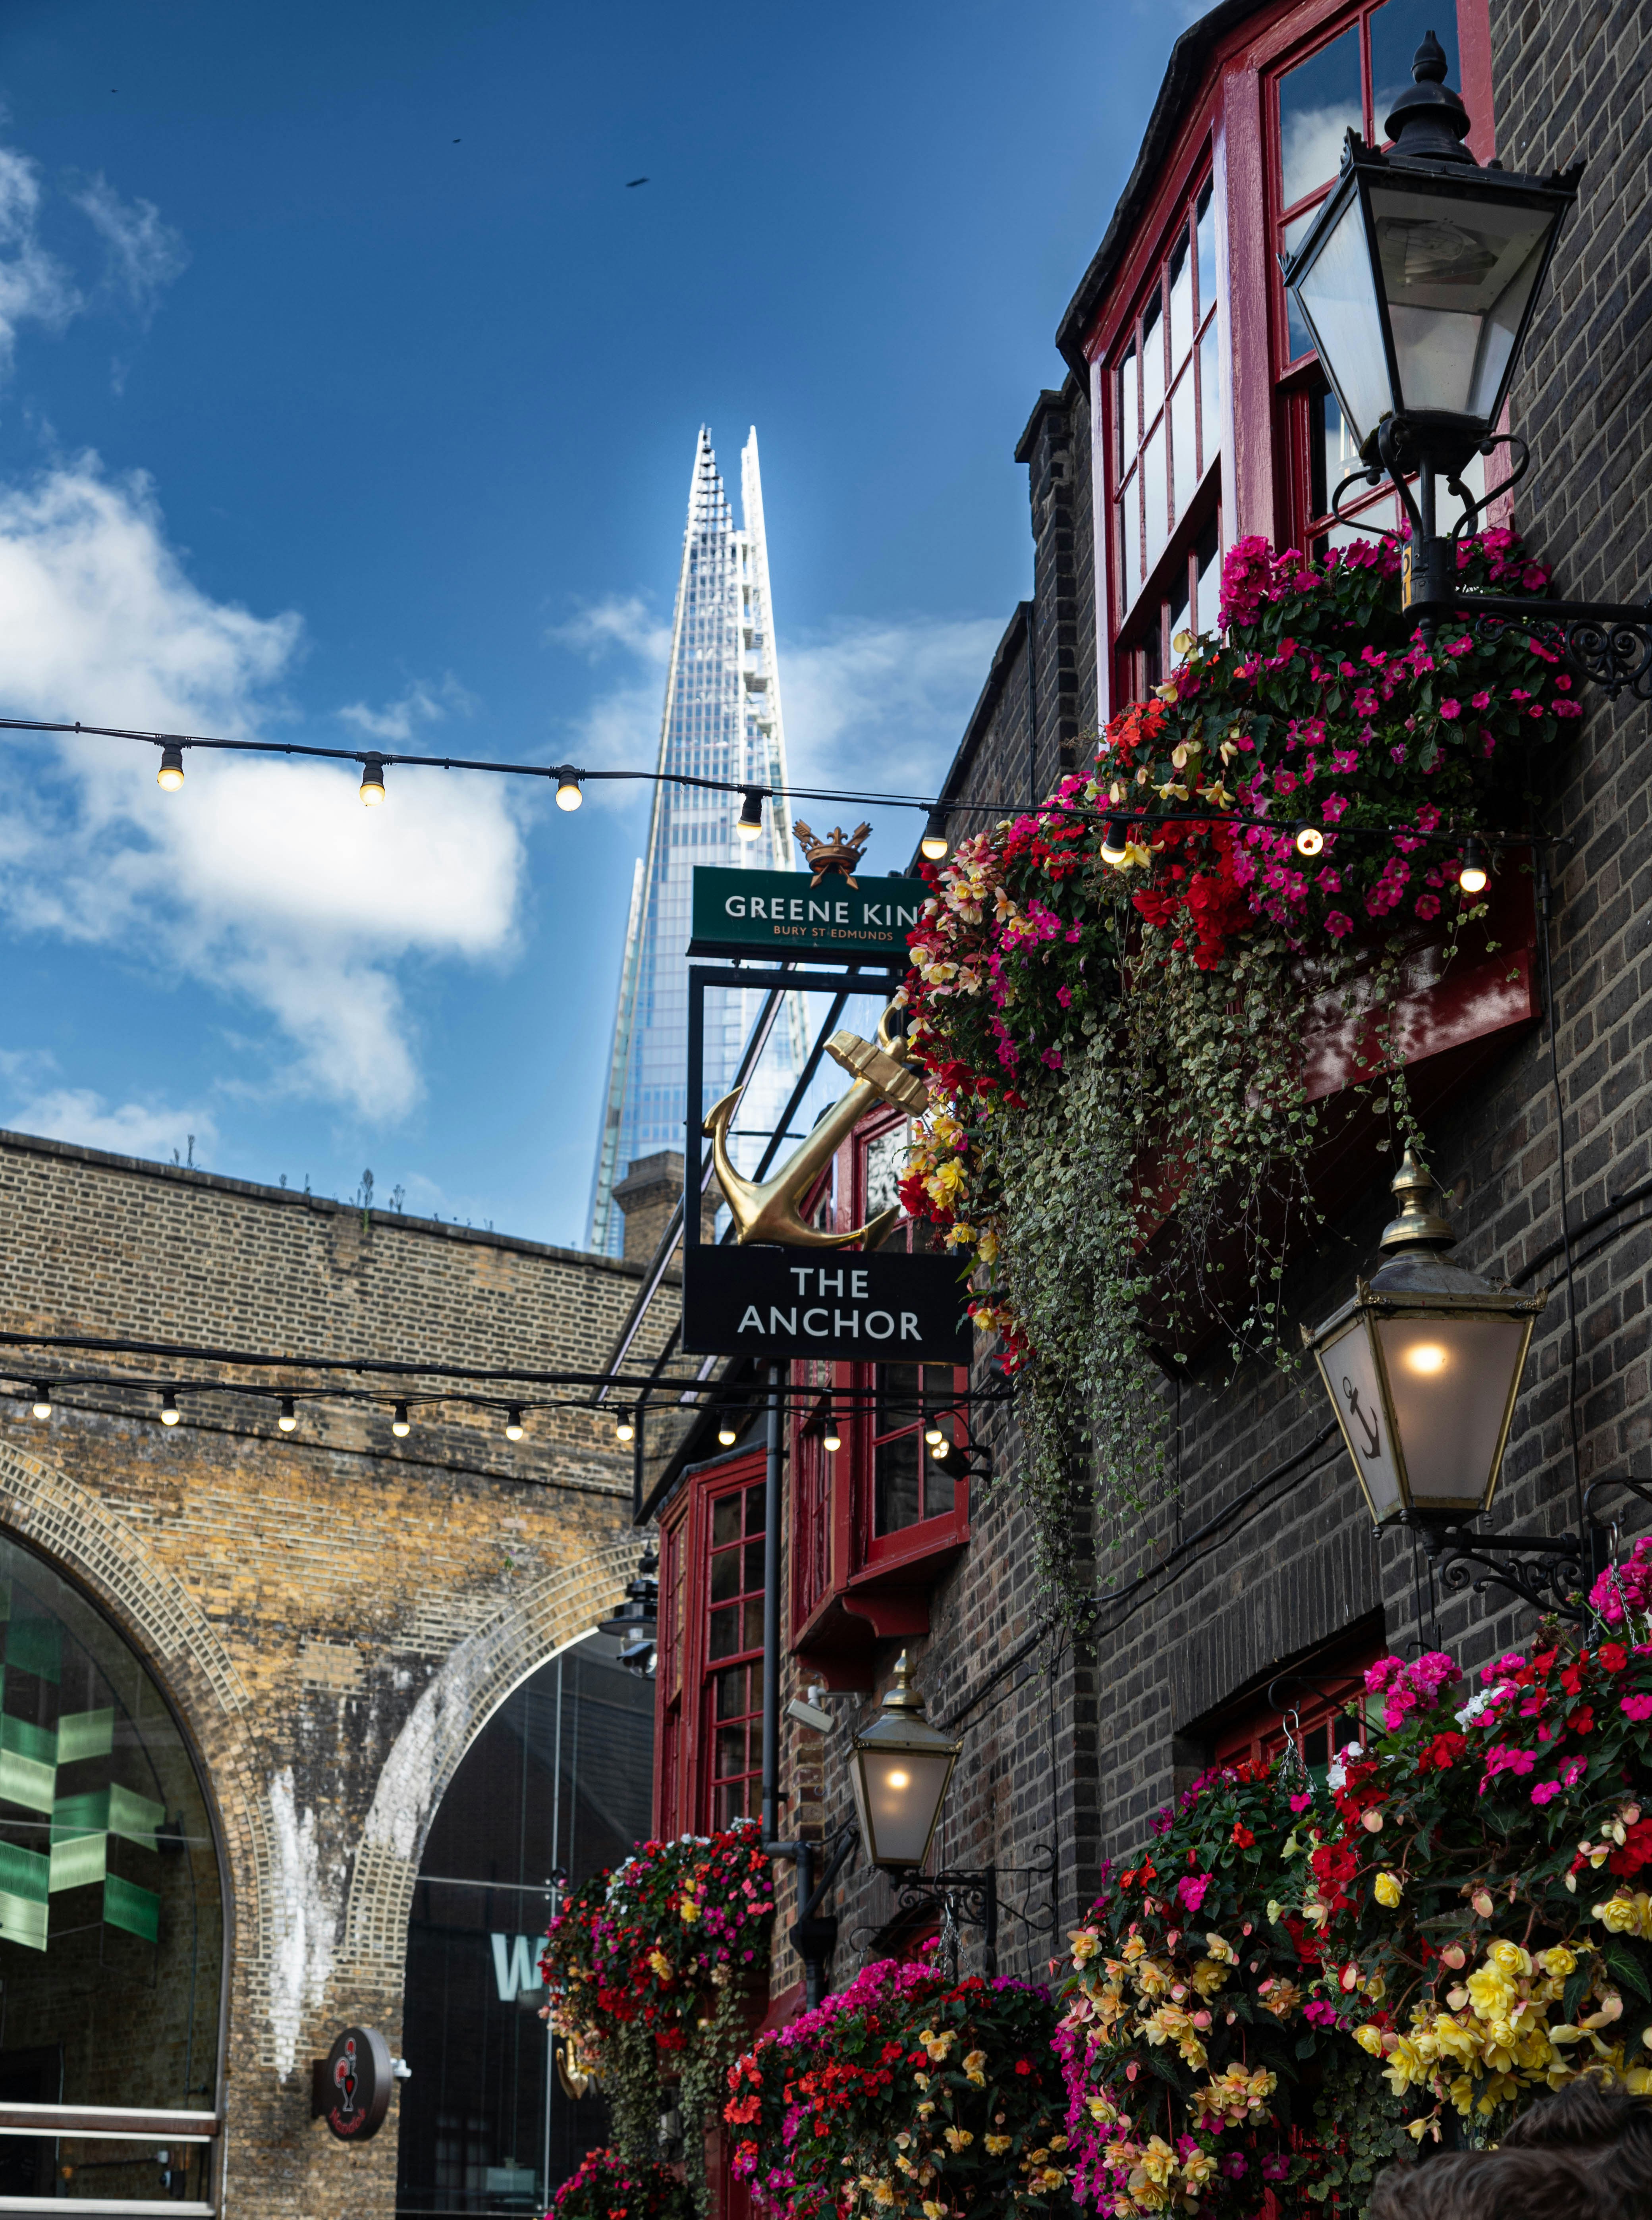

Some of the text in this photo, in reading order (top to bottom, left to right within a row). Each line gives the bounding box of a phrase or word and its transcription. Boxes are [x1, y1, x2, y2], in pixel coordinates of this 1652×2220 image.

[725, 895, 926, 927] GREENE KIN
[774, 926, 893, 941] BURY ST EDMUNDS
[790, 1267, 869, 1298] THE
[737, 1305, 922, 1341] ANCHOR
